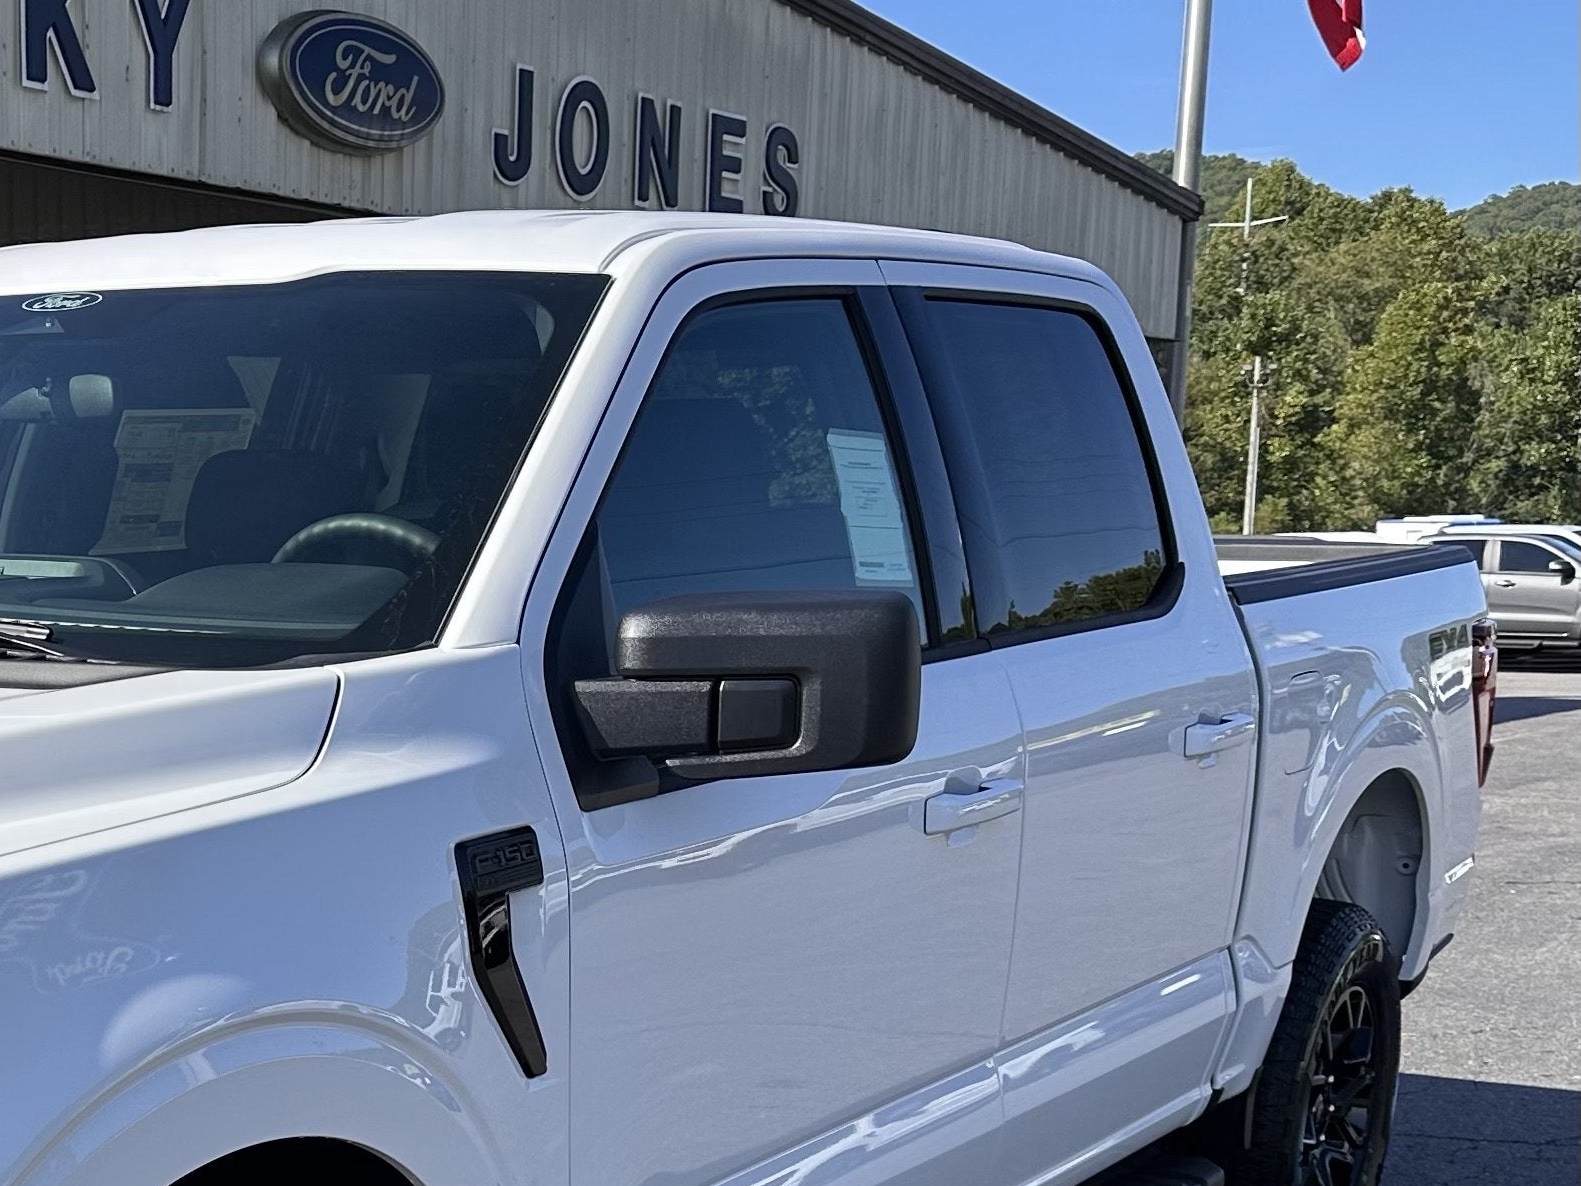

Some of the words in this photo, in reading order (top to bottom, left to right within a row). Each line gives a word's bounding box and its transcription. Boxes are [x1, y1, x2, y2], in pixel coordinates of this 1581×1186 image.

[325, 40, 419, 122] Ford
[492, 63, 799, 217] JONES
[32, 294, 90, 309] Ford
